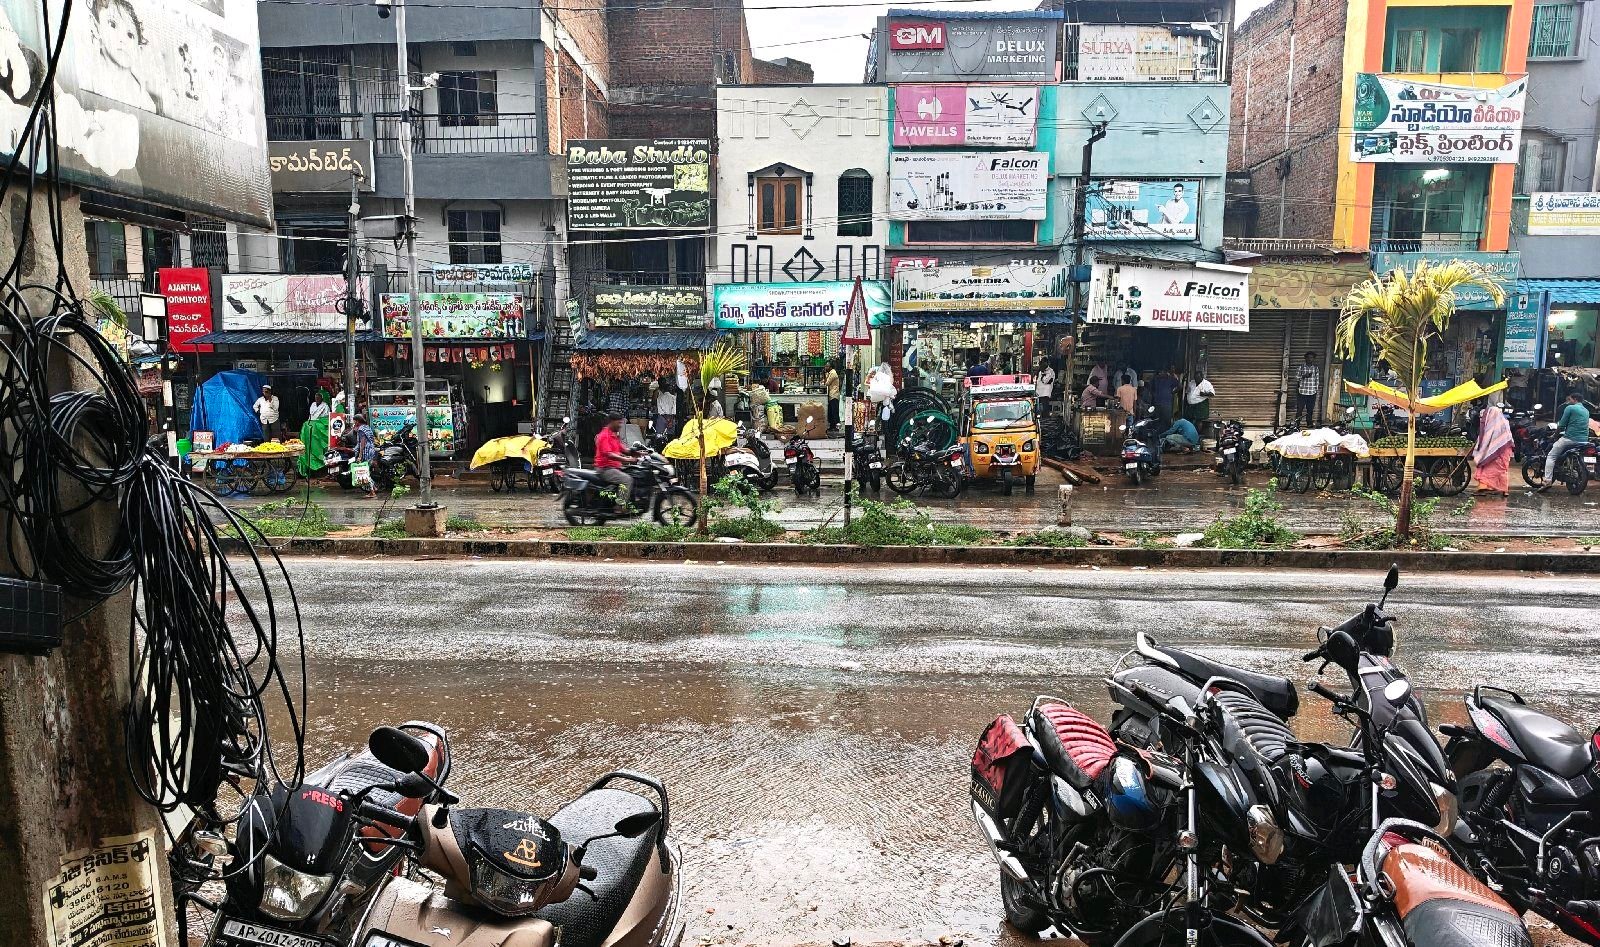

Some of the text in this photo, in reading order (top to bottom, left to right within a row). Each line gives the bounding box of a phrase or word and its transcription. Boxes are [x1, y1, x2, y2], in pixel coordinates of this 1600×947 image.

[996, 40, 1045, 52] DELUX
[1081, 42, 1132, 54] SURYA
[987, 55, 1045, 63] MARKETING
[1392, 103, 1520, 132] స్టూడియో వీడియో
[900, 126, 958, 136] HAVELLS
[1436, 133, 1514, 154] ప్రింటింగ్
[568, 146, 707, 164] Baba Studio
[990, 158, 1038, 171] Falcon
[168, 284, 201, 292] AJANTHA
[1184, 282, 1240, 298] Falcon
[720, 304, 745, 324] న్యూ
[790, 300, 834, 318] జనరల్
[1152, 309, 1246, 324] DELUXE AGENCIES
[970, 780, 996, 811] CLASSIC
[238, 924, 254, 938] AP
